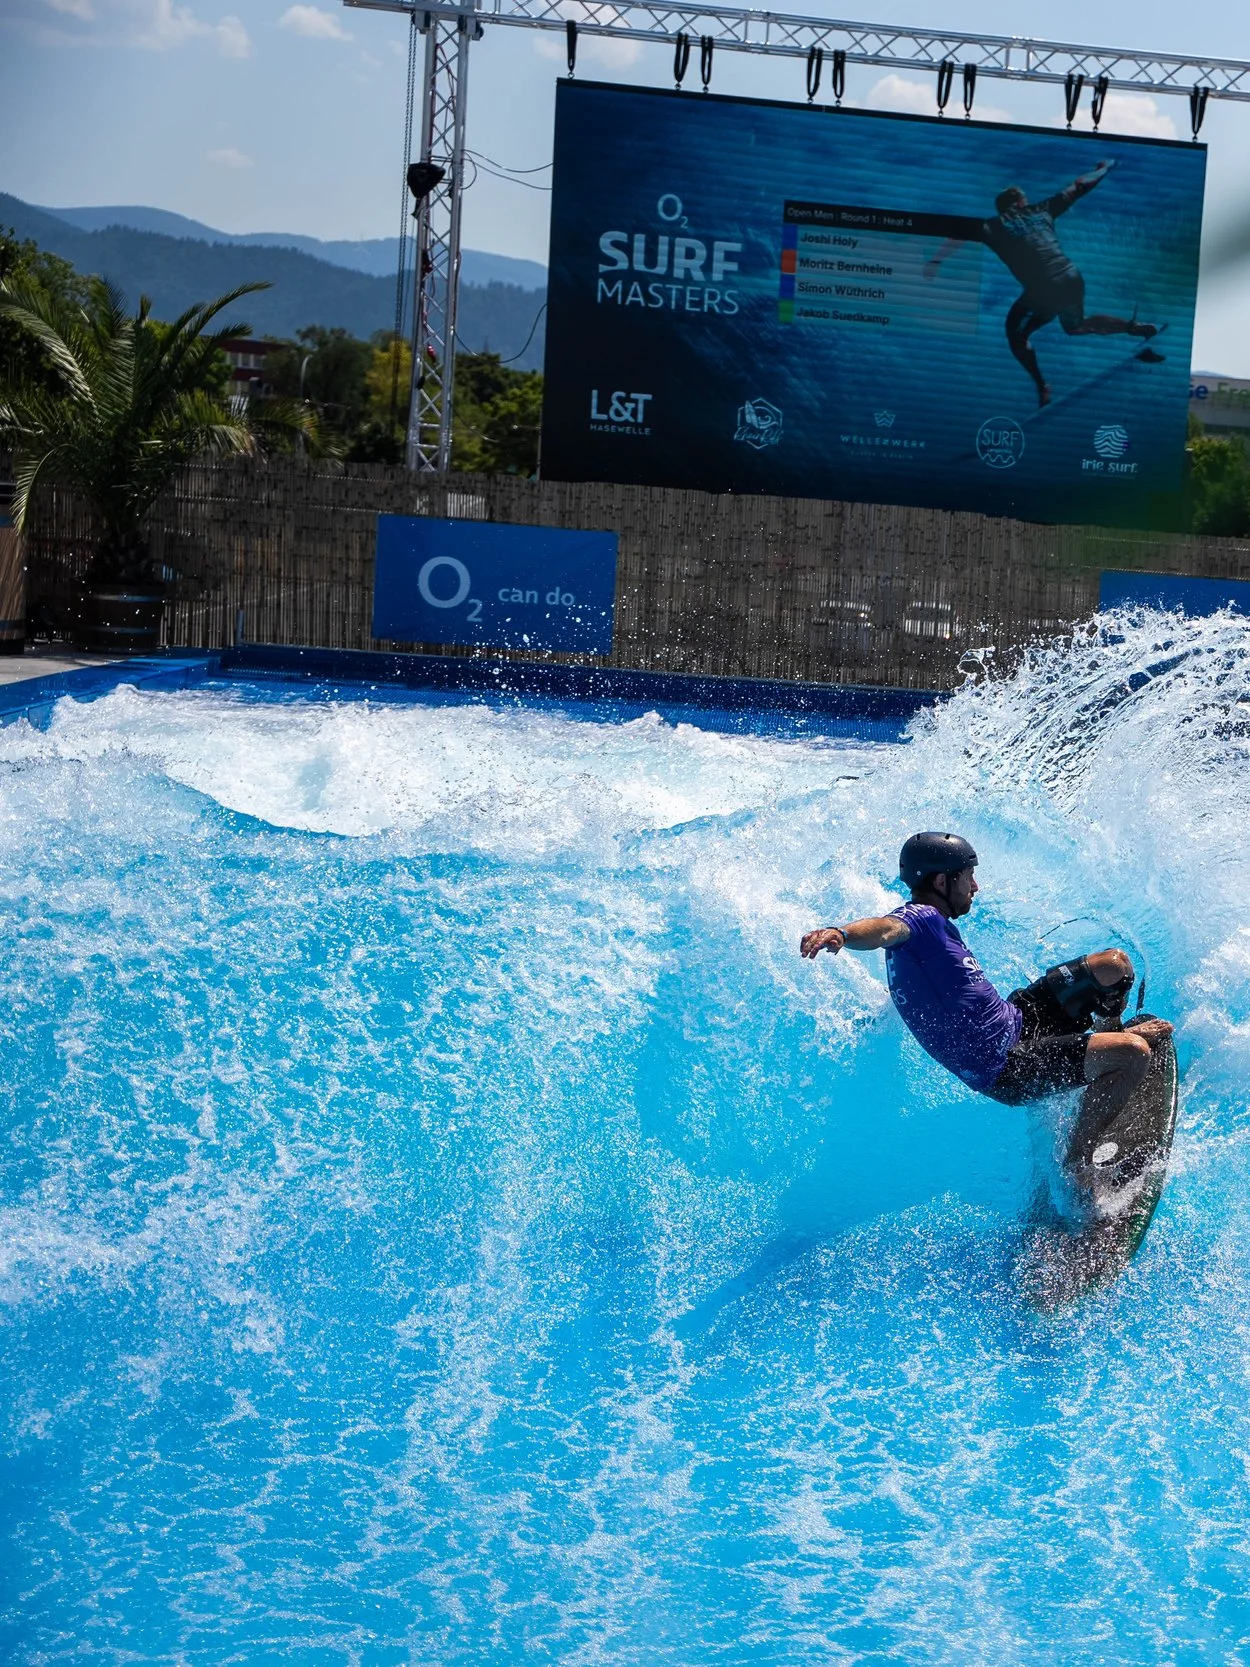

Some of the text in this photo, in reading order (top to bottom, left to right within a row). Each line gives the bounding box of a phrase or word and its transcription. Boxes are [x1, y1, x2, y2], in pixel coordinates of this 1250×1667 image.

[787, 207, 812, 218] Open
[814, 210, 833, 220] Men
[841, 212, 870, 224] Round
[883, 217, 904, 226] Heat
[906, 218, 913, 227] 4
[801, 233, 859, 249] Joshi Holy
[598, 230, 742, 282] SURF
[799, 258, 893, 276] Moritz Bernheine
[597, 278, 739, 315] MASTERS
[798, 281, 885, 300] Simon Wüthrich
[796, 307, 890, 326] Jakob Suedkamp
[590, 389, 652, 424] L&T
[590, 423, 651, 436] HASEWELLE
[981, 428, 1020, 447] SURF
[498, 587, 538, 604] can
[545, 587, 575, 606] do
